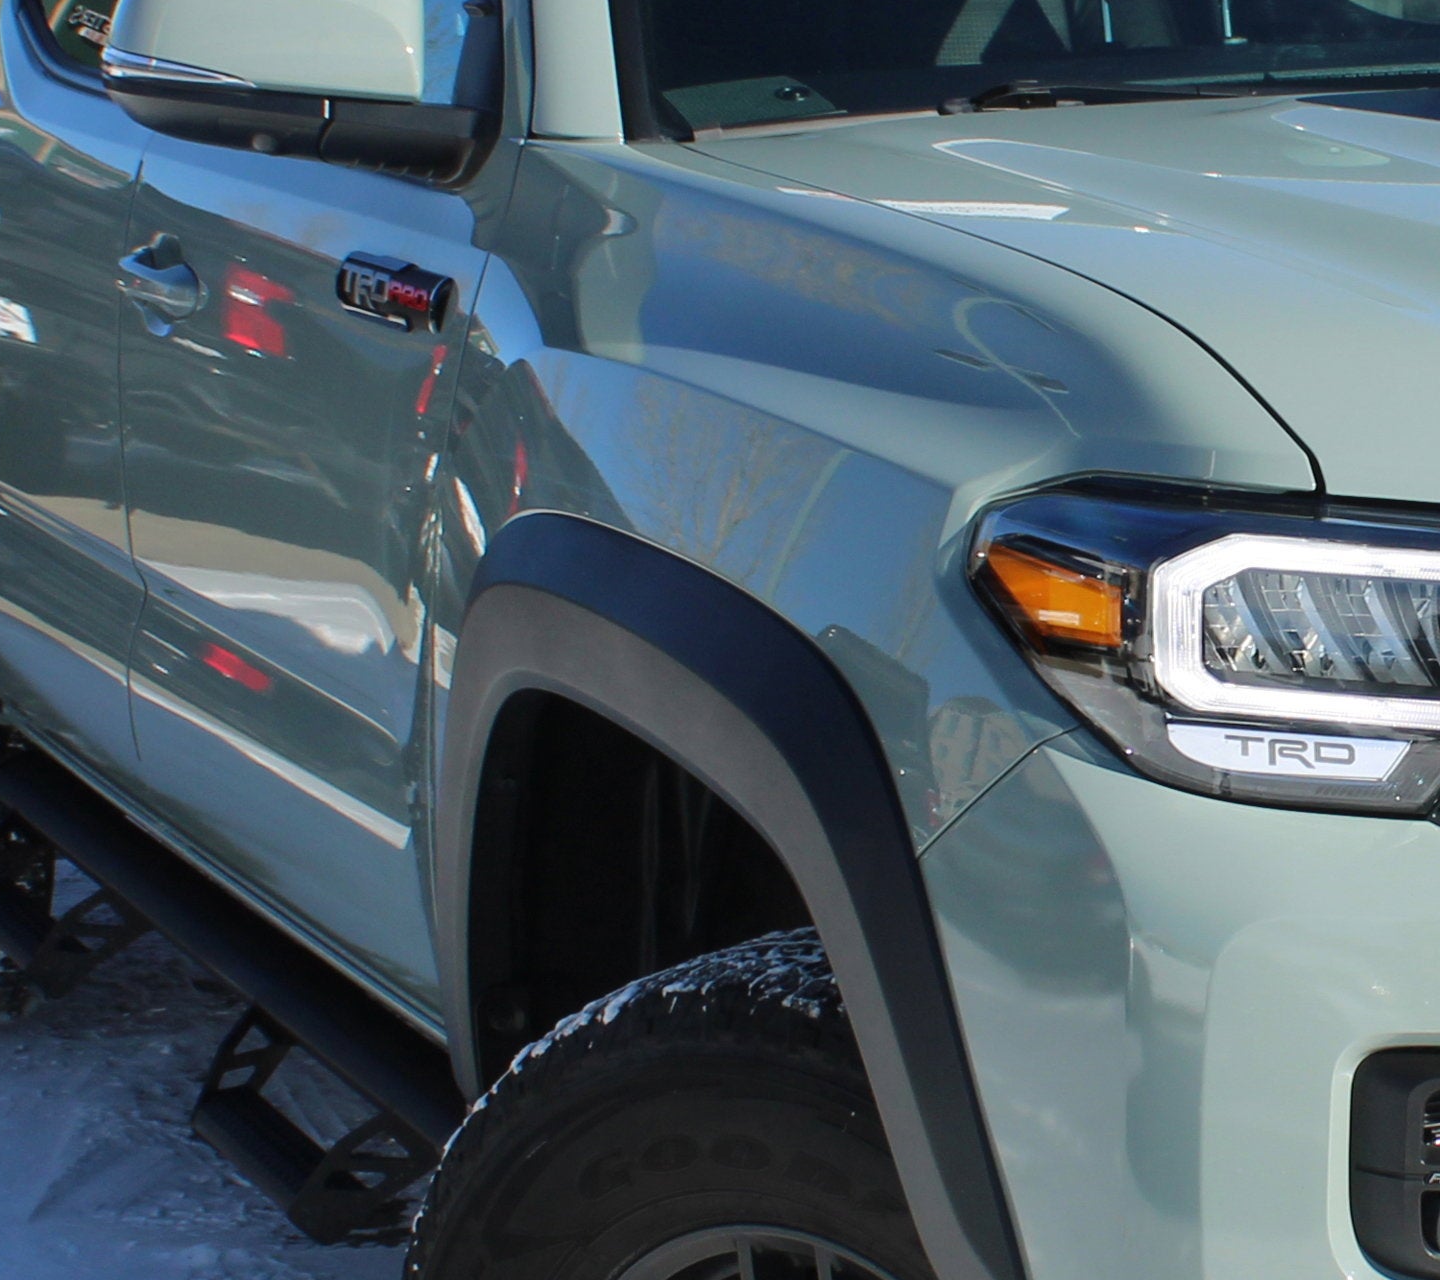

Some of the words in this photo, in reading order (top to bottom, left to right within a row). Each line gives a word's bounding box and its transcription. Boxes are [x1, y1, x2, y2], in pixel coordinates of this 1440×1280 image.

[342, 261, 391, 310] TRD
[389, 279, 429, 312] PRO
[1224, 734, 1356, 770] TRD
